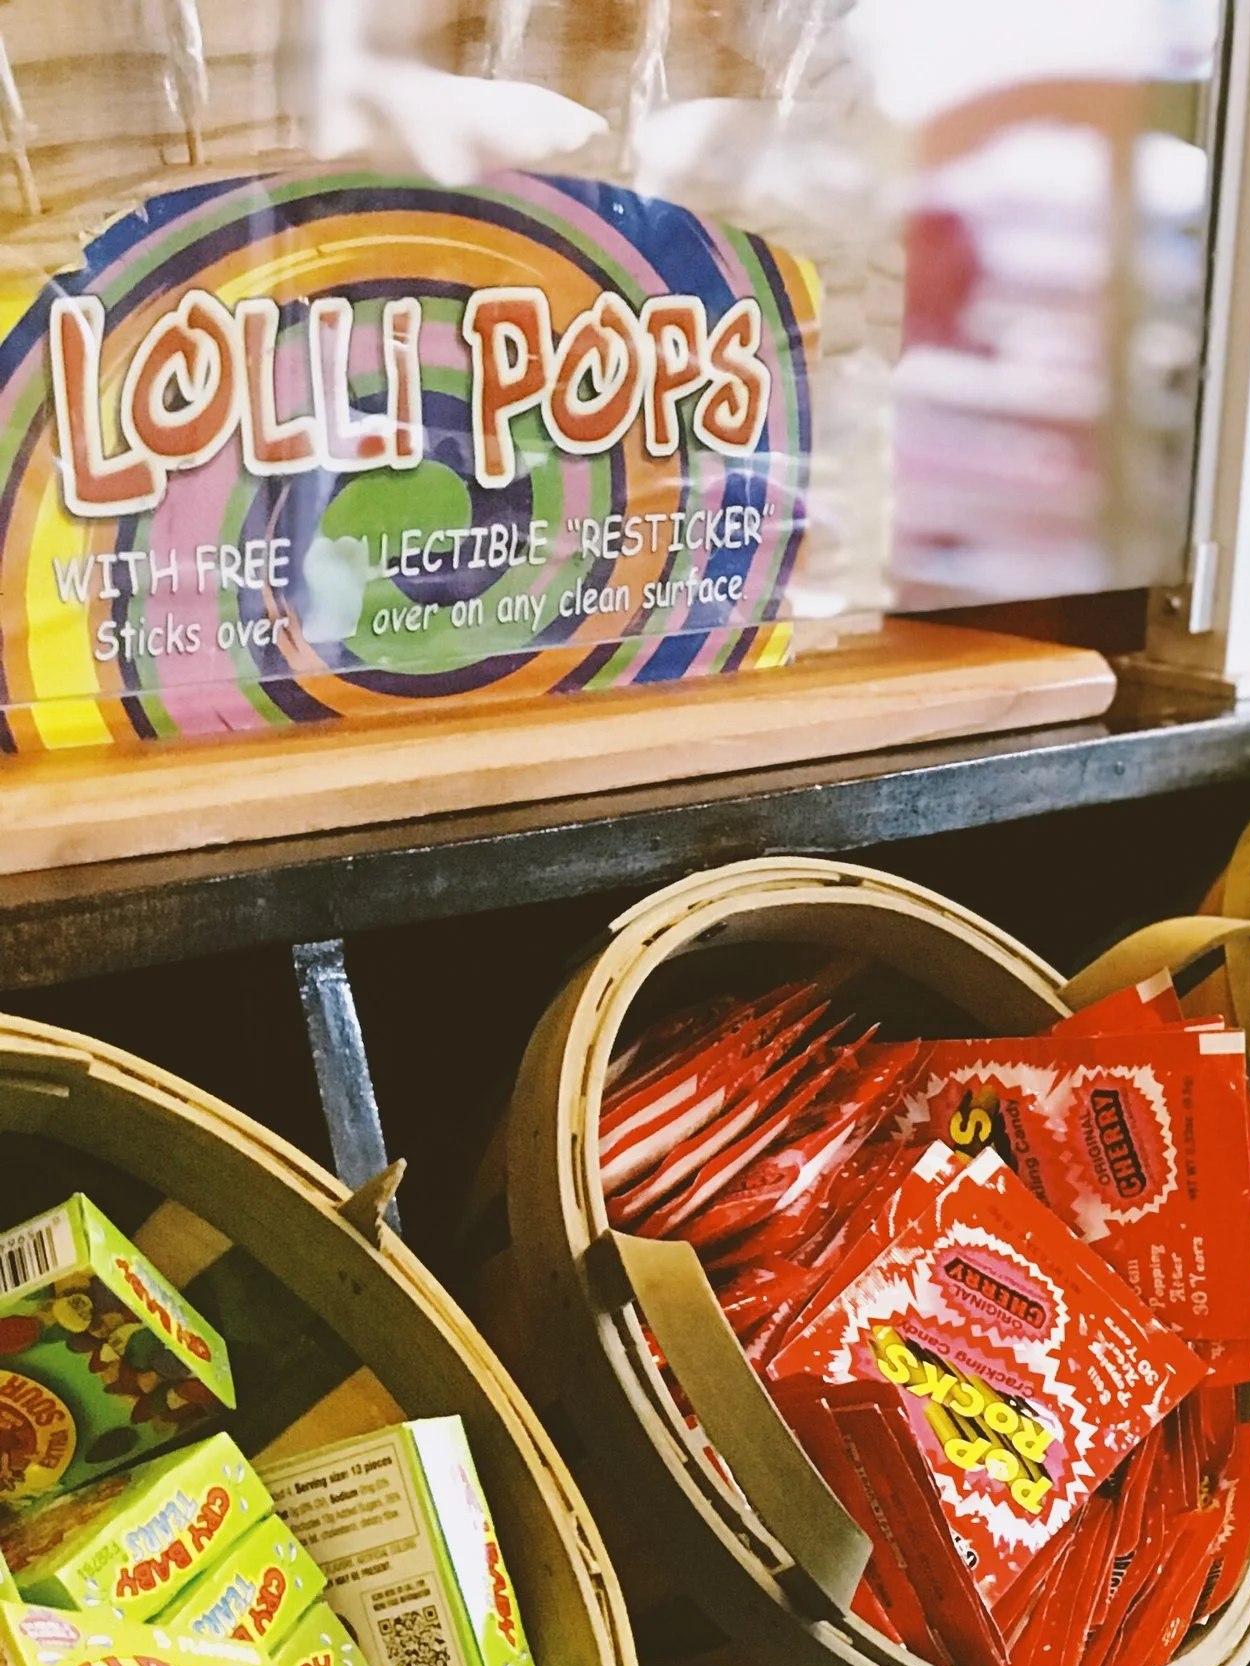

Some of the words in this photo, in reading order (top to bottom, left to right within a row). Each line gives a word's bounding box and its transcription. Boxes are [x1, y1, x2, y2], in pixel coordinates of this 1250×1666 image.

[465, 287, 770, 487] POPS
[53, 549, 178, 603] WITH
[196, 538, 291, 593] FREE
[94, 613, 201, 662] Sticks
[217, 617, 290, 650] over
[372, 603, 438, 636] over
[451, 600, 484, 628] on
[497, 593, 546, 632] any
[559, 584, 629, 618] clean
[642, 567, 749, 609] surface.
[1079, 1111, 1110, 1186] ORIGINAL
[1091, 1089, 1147, 1199] CHERRY
[1149, 1243, 1166, 1311] Popping
[1169, 1252, 1186, 1303] After
[1189, 1236, 1204, 1285] Years
[944, 1257, 1048, 1331] CHERRY
[951, 1283, 1024, 1332] ORIGINAL
[1190, 1290, 1209, 1317] 30
[900, 1319, 950, 1356] Candy
[0, 1374, 66, 1427] SOUR
[877, 1343, 1055, 1464] ROCKS
[954, 1351, 1036, 1398] Crackling
[1136, 1358, 1159, 1387] 30
[944, 1437, 1053, 1515] POP
[188, 1487, 231, 1552] CRY
[116, 1539, 193, 1597] BABY
[248, 1567, 286, 1637] CRY
